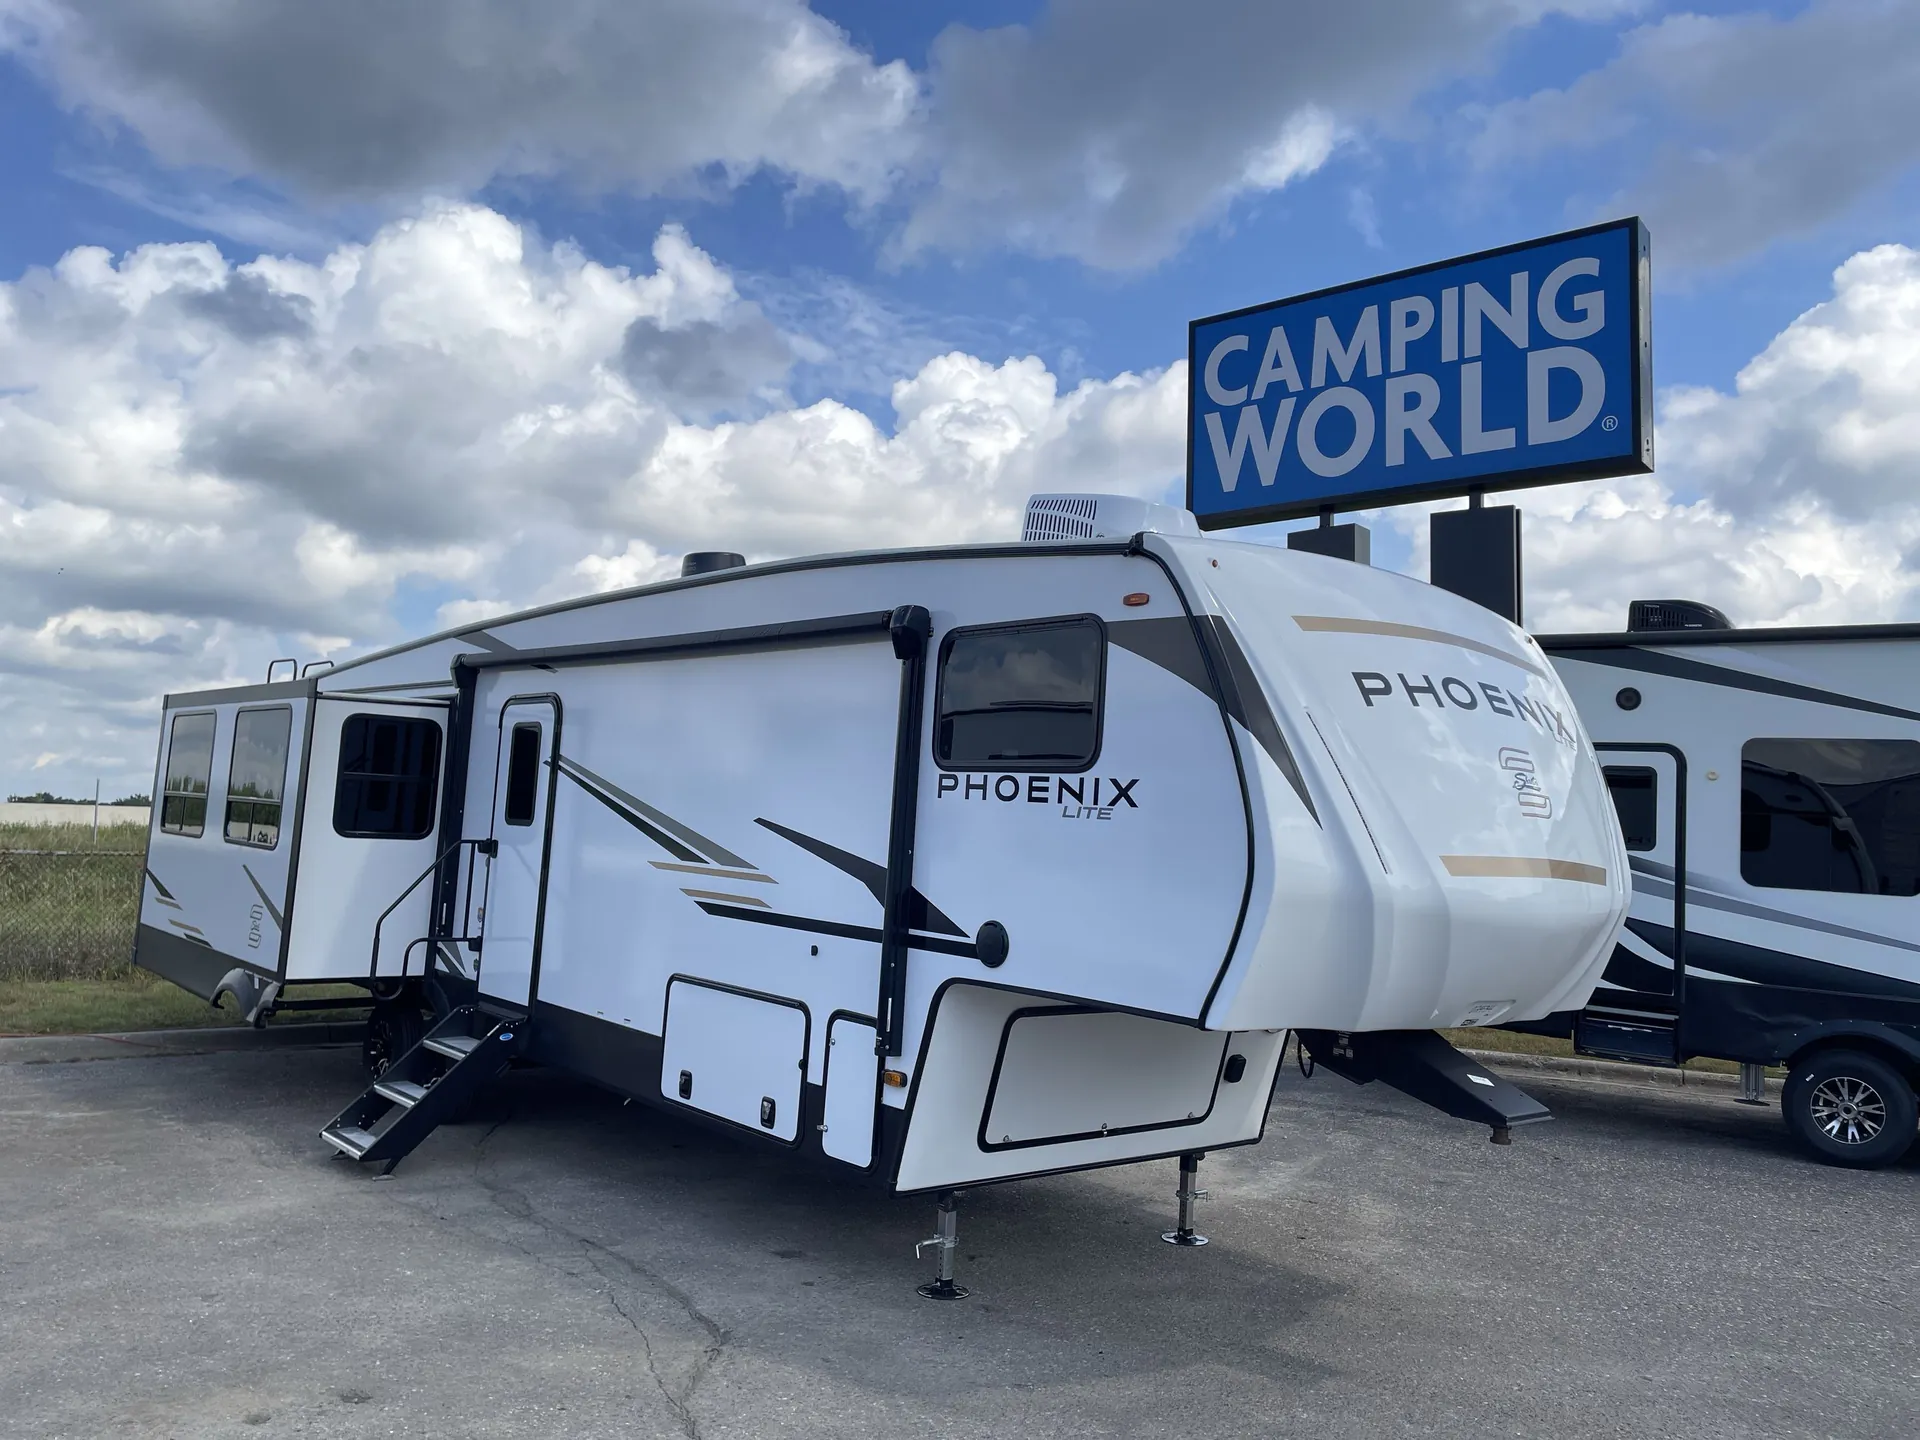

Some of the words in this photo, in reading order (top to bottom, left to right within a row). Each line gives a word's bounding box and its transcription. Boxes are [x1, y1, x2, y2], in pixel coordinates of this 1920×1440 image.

[1204, 257, 1605, 406] CAMPING
[1204, 345, 1606, 493] WORLD
[1351, 671, 1577, 744] PHOENIX
[937, 773, 1141, 808] PHOENIX
[1061, 805, 1114, 821] LITE
